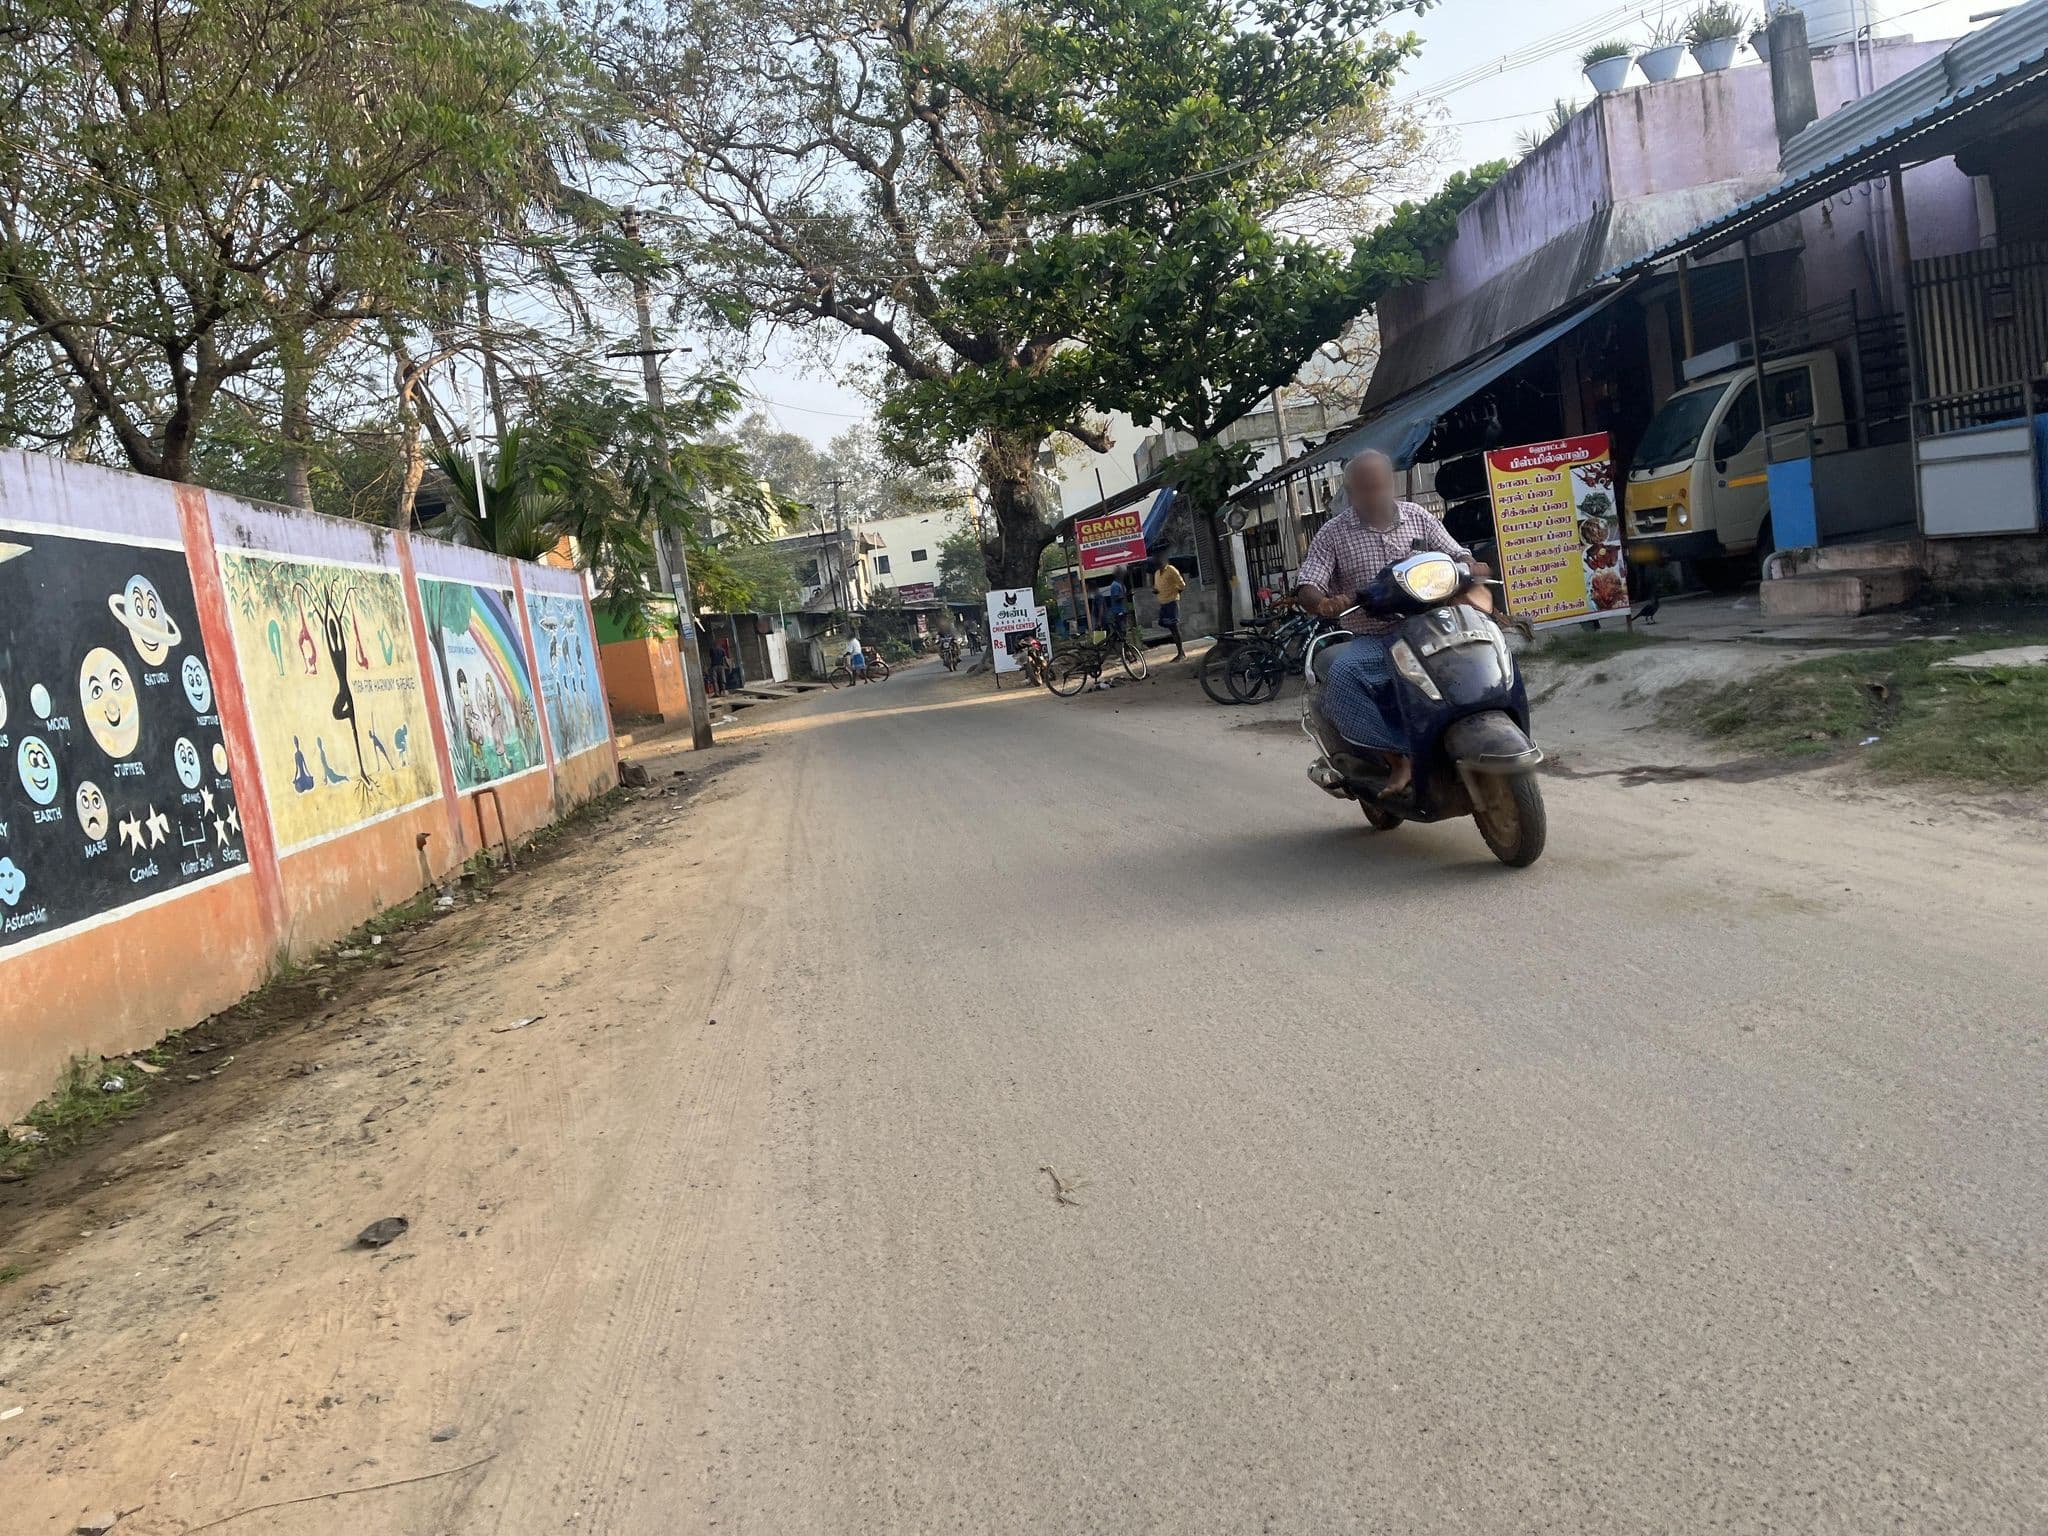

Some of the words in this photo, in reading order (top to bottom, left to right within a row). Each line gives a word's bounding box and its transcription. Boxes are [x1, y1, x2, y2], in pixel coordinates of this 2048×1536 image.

[1497, 479, 1532, 489] காடை
[1535, 473, 1562, 483] ப்ரை
[1527, 489, 1554, 499] ப்ரை
[1500, 504, 1538, 518] சிக்கன்
[1542, 501, 1568, 512] ப்ரை
[1081, 516, 1137, 535] GRAND
[1546, 516, 1571, 526] ப்ரை
[1082, 526, 1139, 544] RESIDENCY
[1547, 530, 1573, 540] ப்ரை
[1530, 557, 1568, 573] வறுவல்
[1511, 576, 1543, 590] சிக்கன்
[1545, 575, 1559, 584] 65
[1553, 598, 1585, 612] சிக்கன்
[998, 607, 1028, 619] அன்பு
[992, 624, 1015, 633] CHICKEN
[1016, 622, 1036, 631] CENTER
[993, 639, 1006, 649] Rs.
[144, 672, 170, 687] SATURN
[46, 717, 71, 732] MOON
[113, 762, 146, 777] JUPITER
[33, 807, 63, 823] EARTH
[84, 839, 108, 858] MARS
